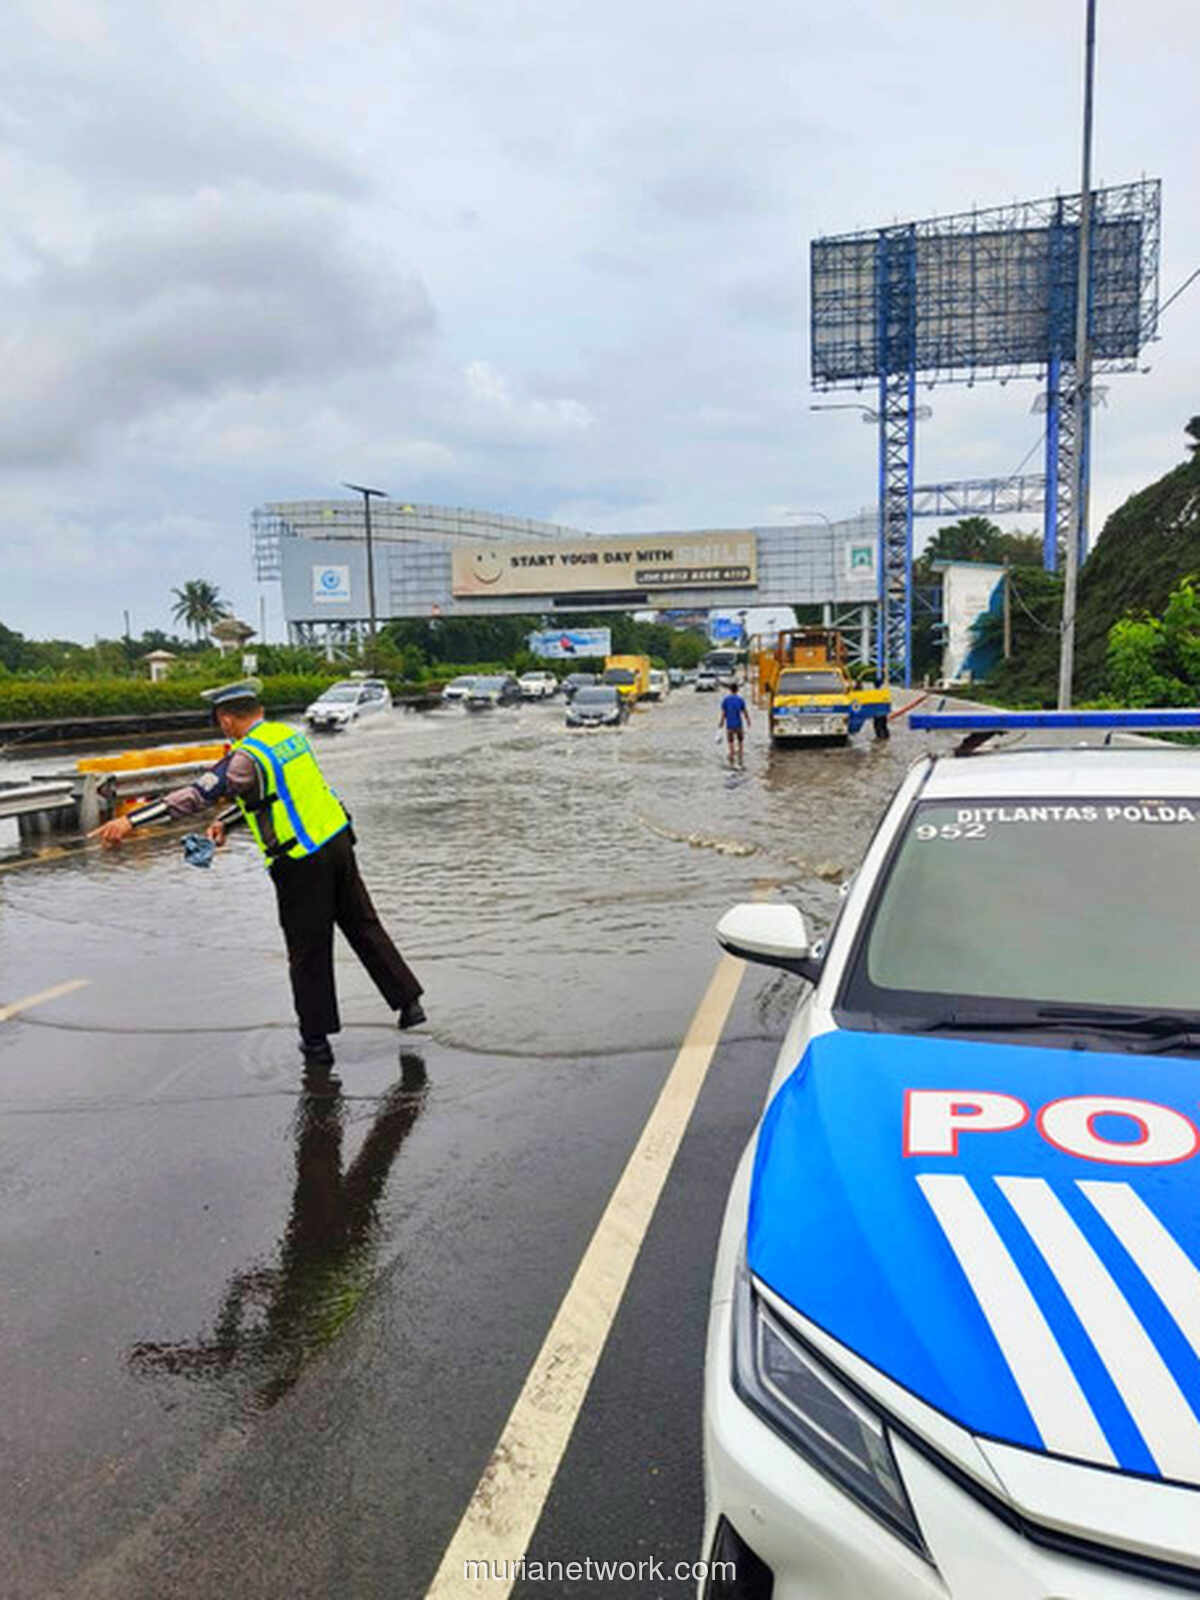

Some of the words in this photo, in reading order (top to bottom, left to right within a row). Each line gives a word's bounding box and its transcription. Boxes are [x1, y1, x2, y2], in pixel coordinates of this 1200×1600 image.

[510, 554, 556, 567] START
[560, 552, 599, 565] YOUR
[603, 551, 632, 564] DAY
[636, 549, 674, 562] WITH
[957, 806, 1098, 824] DITLANTAS
[1105, 805, 1196, 823] POLDA
[916, 824, 987, 840] 952
[902, 1088, 1200, 1166] PO
